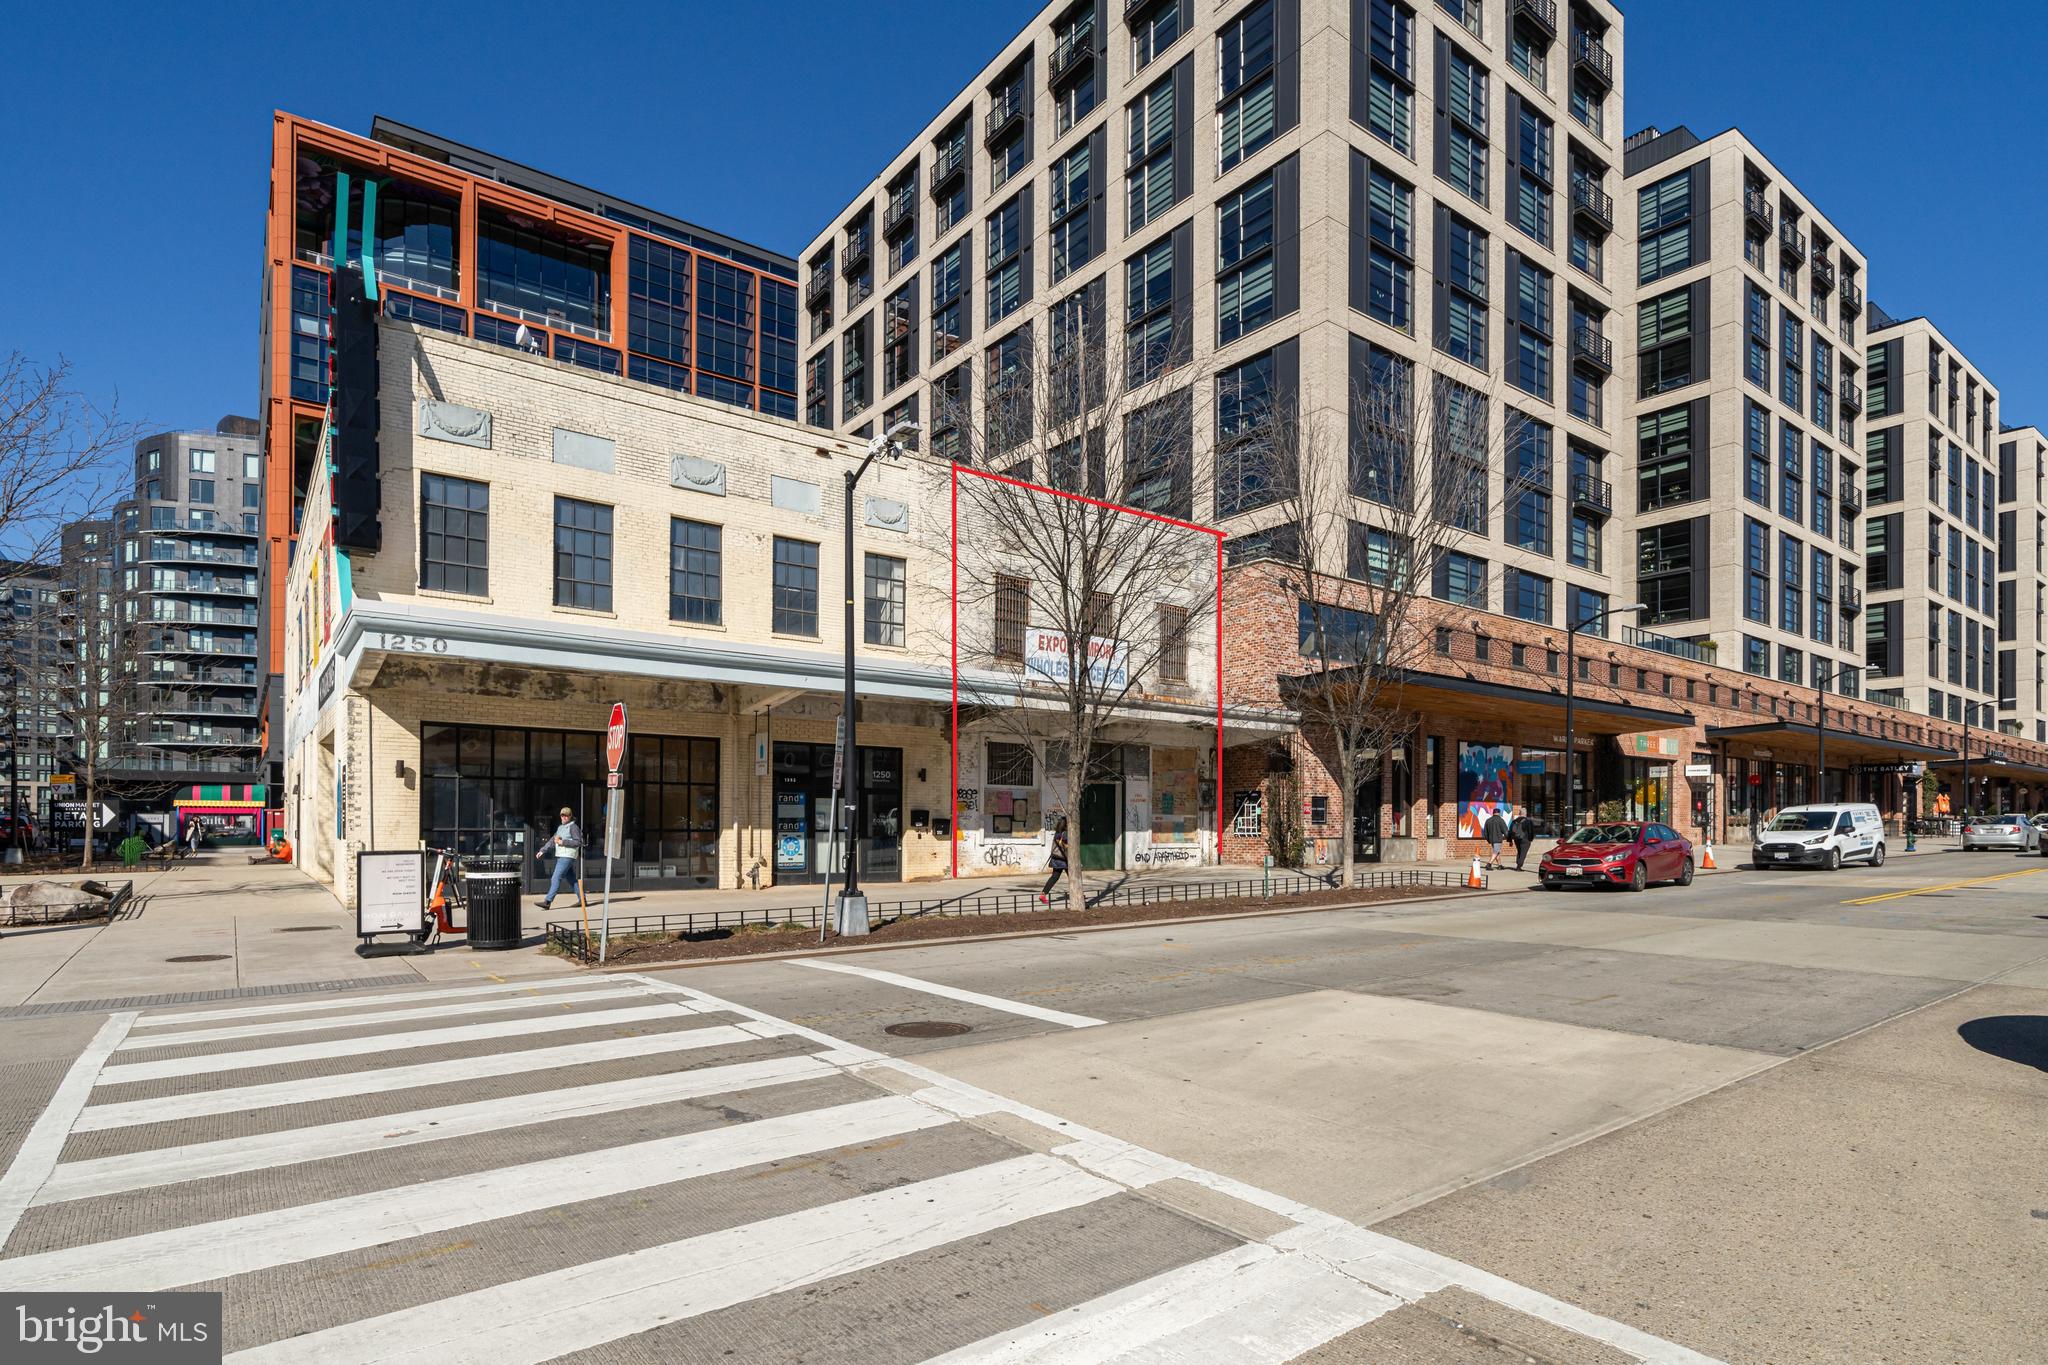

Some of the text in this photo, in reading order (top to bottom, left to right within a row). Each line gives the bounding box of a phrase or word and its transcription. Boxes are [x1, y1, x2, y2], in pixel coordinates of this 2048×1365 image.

[380, 633, 448, 654] 1250
[608, 725, 624, 750] STOP
[873, 771, 891, 779] 1250
[54, 812, 100, 820] RETAL
